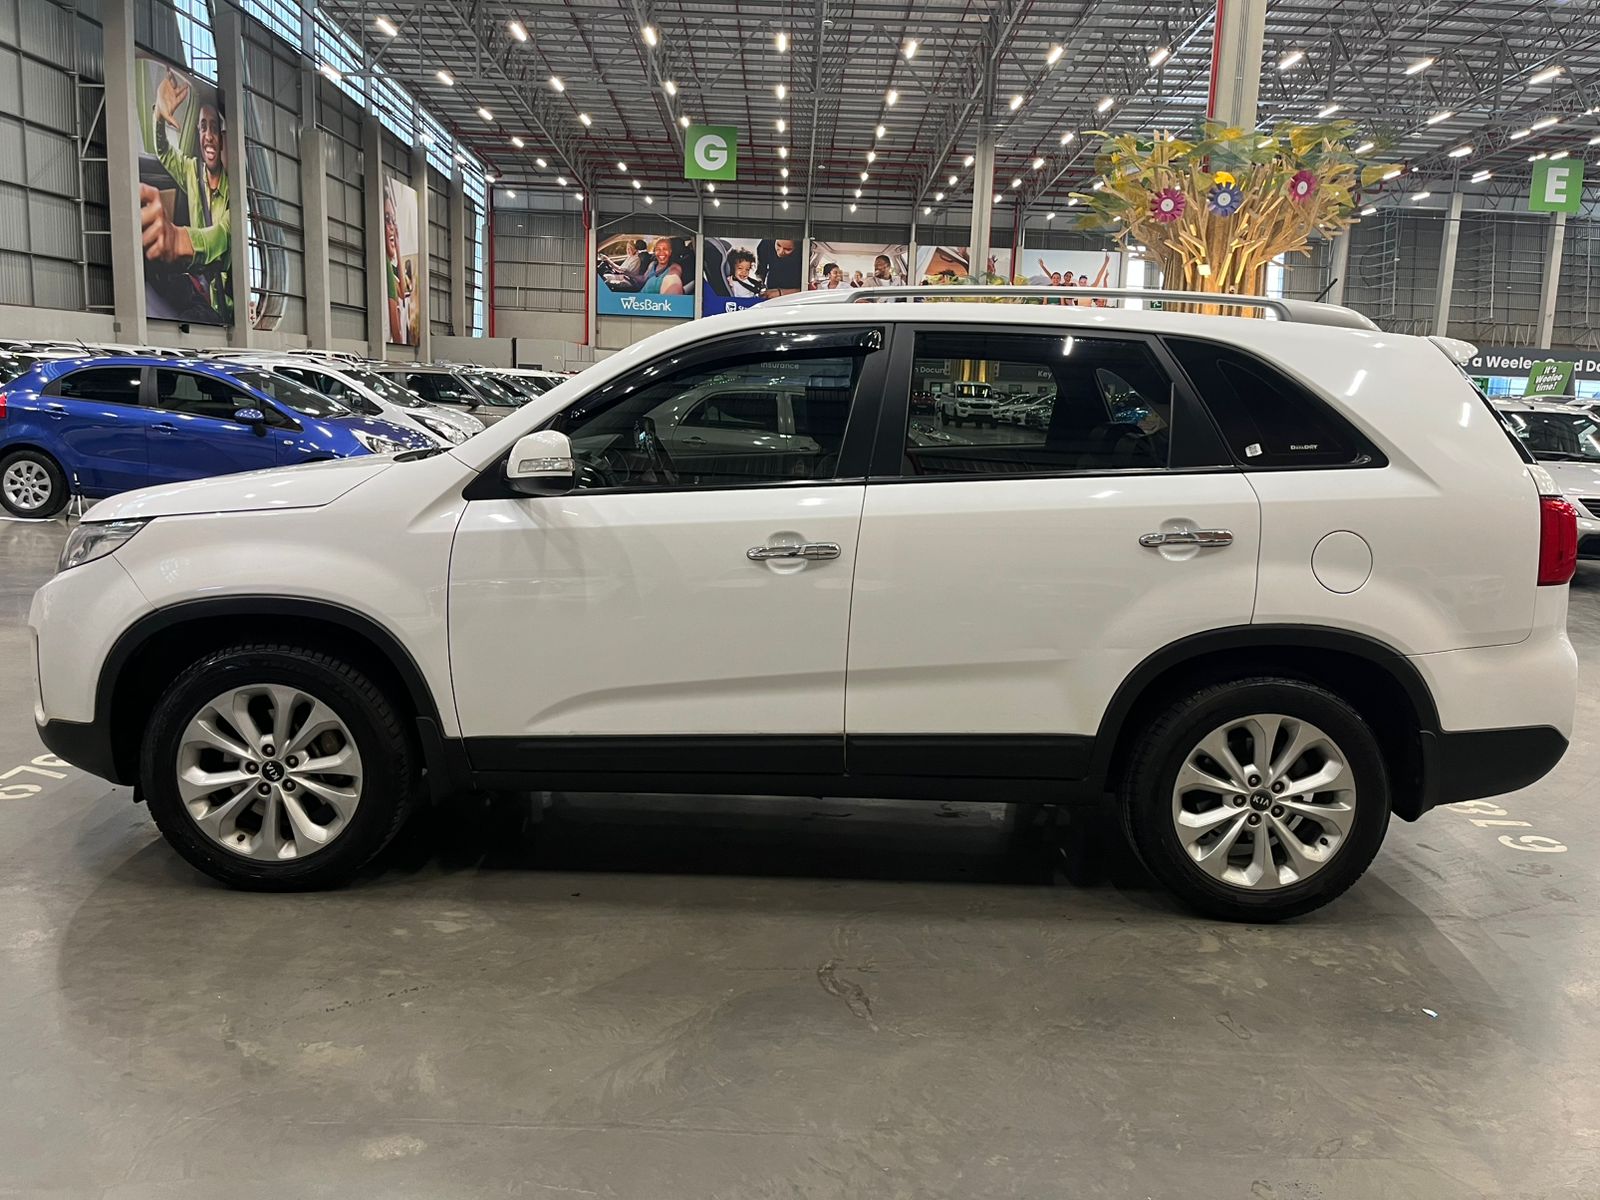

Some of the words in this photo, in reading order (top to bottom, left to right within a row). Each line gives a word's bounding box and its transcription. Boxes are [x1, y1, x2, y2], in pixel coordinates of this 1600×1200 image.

[694, 134, 728, 171] G
[1544, 167, 1570, 203] E
[620, 296, 672, 312] WesBank
[1486, 355, 1541, 370] Weele
[1543, 365, 1558, 374] It's
[1252, 795, 1270, 807] KIA
